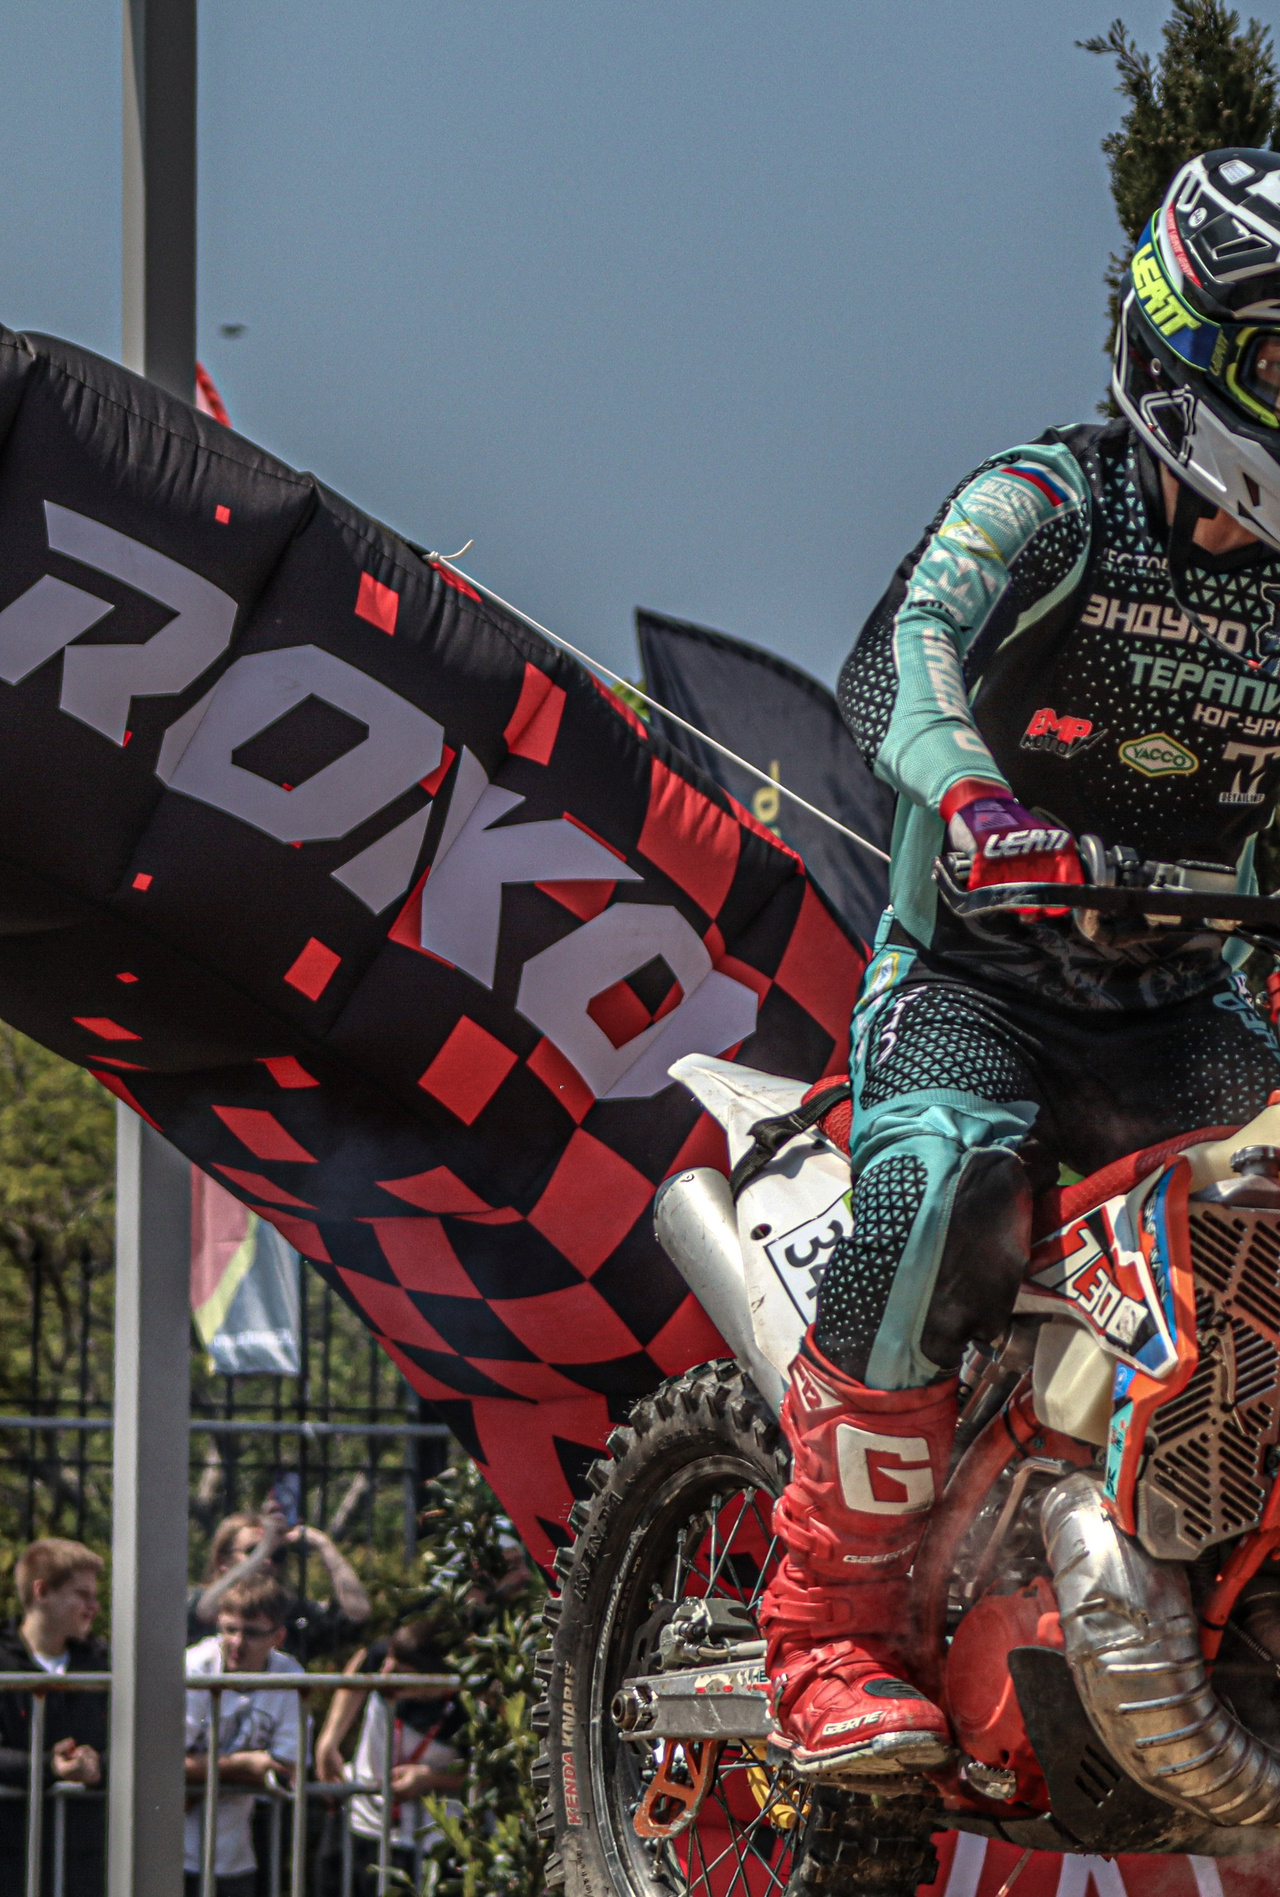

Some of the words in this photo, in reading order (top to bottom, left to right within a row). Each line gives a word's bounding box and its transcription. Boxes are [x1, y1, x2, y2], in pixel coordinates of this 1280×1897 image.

[1131, 242, 1202, 337] LEATT
[1081, 593, 1248, 653] ЭНДУРО
[1133, 747, 1186, 767] YACCO
[562, 1752, 583, 1827] KENDA
